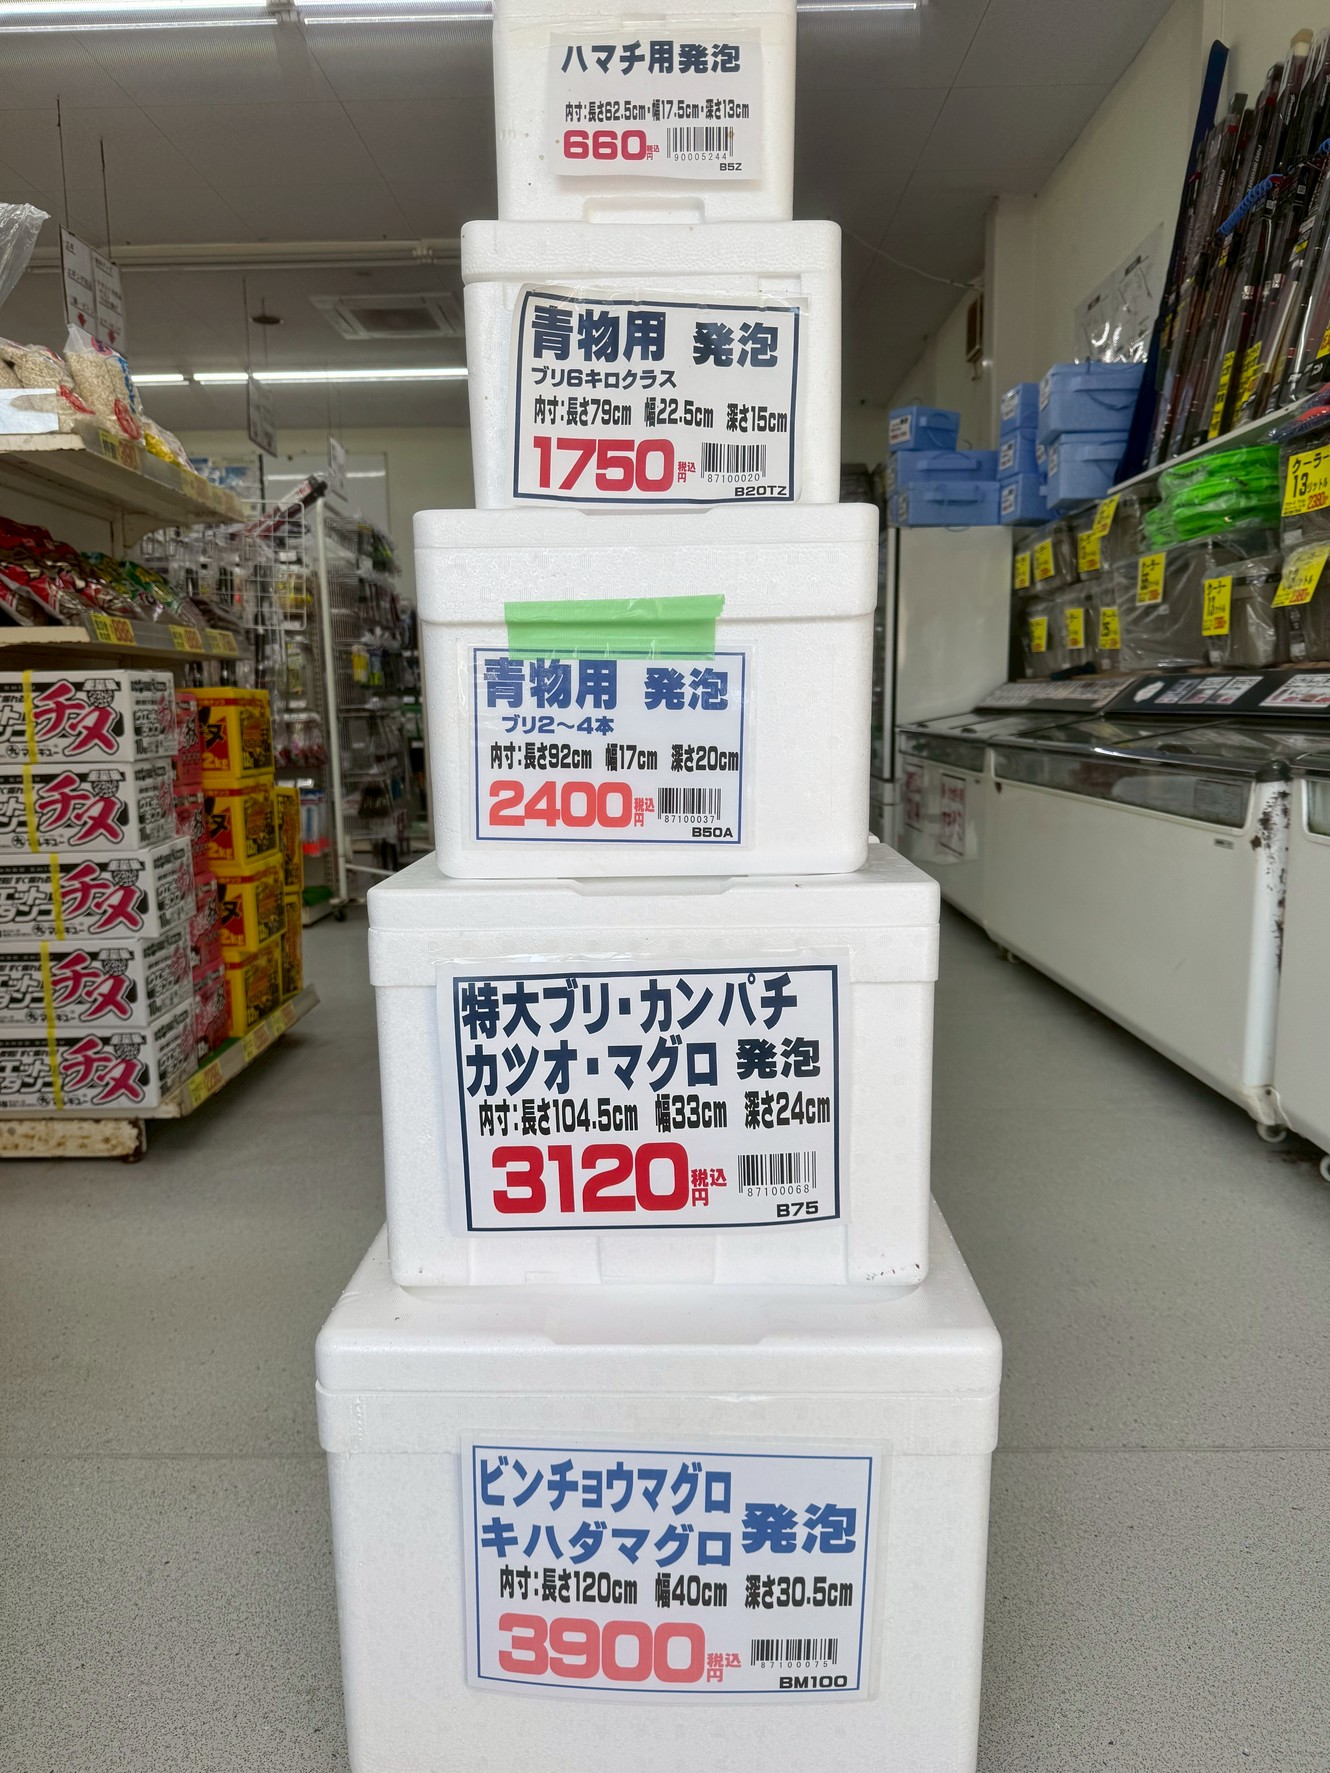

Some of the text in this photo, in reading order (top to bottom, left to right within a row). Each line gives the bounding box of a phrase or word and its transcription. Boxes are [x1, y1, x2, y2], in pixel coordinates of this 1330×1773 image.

[561, 40, 741, 75] ハマチ用発泡
[564, 130, 647, 160] 660
[674, 152, 728, 161] 90005244
[719, 162, 743, 171] B5Z
[531, 305, 779, 368] 青物用 発泡
[531, 366, 678, 389] ブリ6キロクラス
[534, 394, 788, 433] 内寸:長さ79cm 幅22.5cm 深さ15cm
[533, 436, 675, 492] 1750
[678, 461, 696, 473] 税込
[677, 473, 687, 483] 円
[707, 472, 761, 484] 87100020
[734, 485, 788, 497] B20TZ
[484, 656, 729, 711] 青物用 発泡
[20, 747, 60, 757] マキュー
[490, 741, 739, 773] 内寸:長さ92cm 幅17cm 深さ20cm
[489, 780, 632, 828] 2400
[634, 797, 655, 813] 税込
[634, 812, 644, 827] 円
[664, 815, 715, 824] 87100037
[691, 826, 734, 838] B50A
[46, 926, 86, 937] マキュー
[461, 972, 798, 1040] 特大ブリ・カンパチ
[39, 1013, 77, 1022] マキュー
[466, 1034, 821, 1097] カツオ・マグロ 発泡
[479, 1091, 831, 1137] 内寸:長さ104.5cm 幅33cm 深さ24cm
[492, 1142, 690, 1215] 3120
[691, 1168, 727, 1188] 税込
[692, 1187, 710, 1207] 円
[746, 1184, 811, 1198] 87100068
[776, 1200, 819, 1218] B75
[480, 1455, 732, 1516] ビンチョウマグロ
[741, 1503, 857, 1554] 発泡
[481, 1516, 732, 1568] キハダマグロ
[499, 1565, 853, 1610] 内寸:長さ120cm 幅40cm 深さ30.5cm
[498, 1612, 706, 1684] 3900
[706, 1652, 742, 1669] 税込
[760, 1661, 829, 1669] 87100075
[706, 1668, 724, 1684] 円
[779, 1675, 848, 1690] BM100
